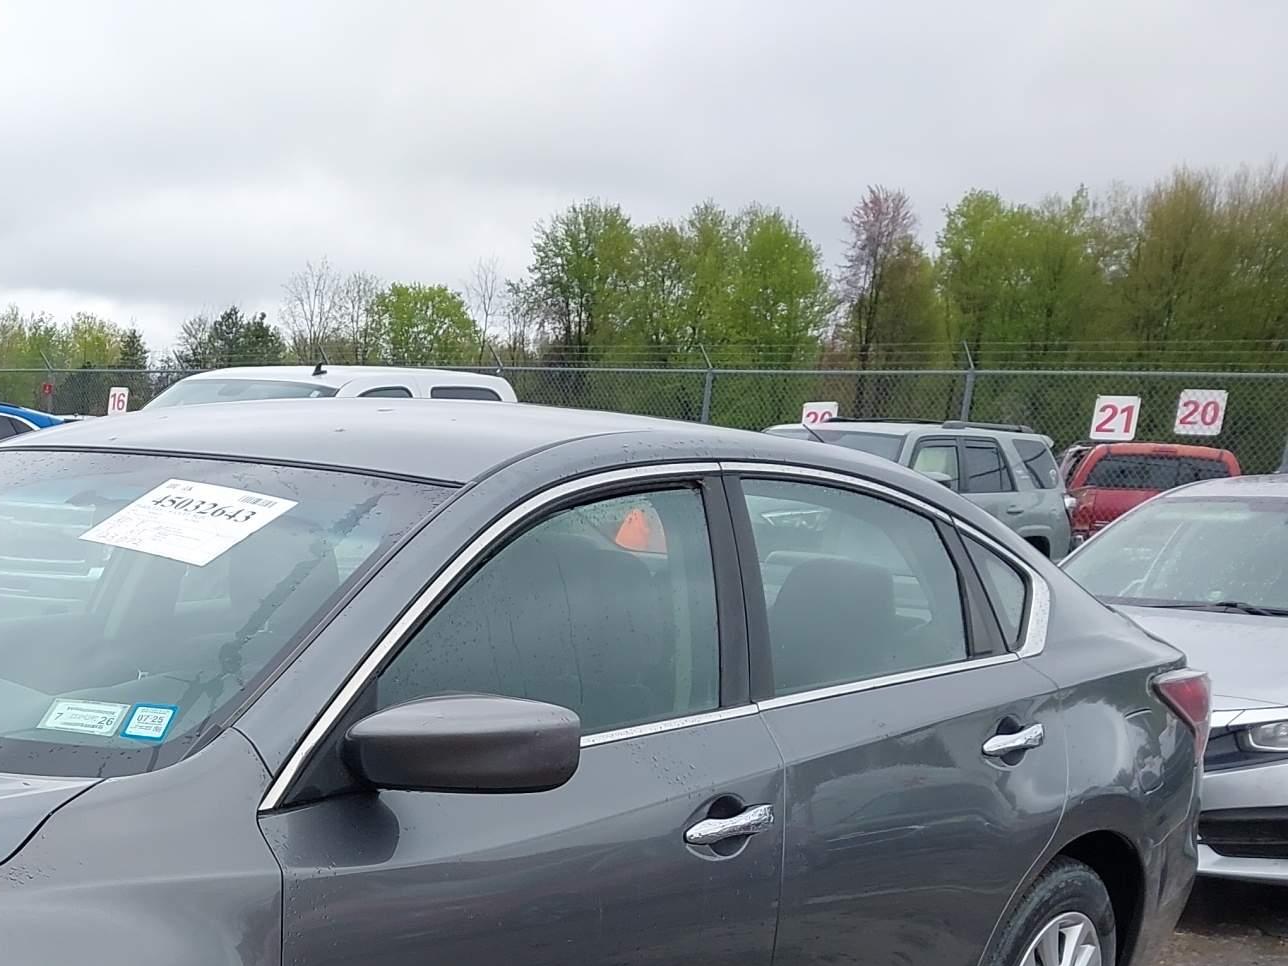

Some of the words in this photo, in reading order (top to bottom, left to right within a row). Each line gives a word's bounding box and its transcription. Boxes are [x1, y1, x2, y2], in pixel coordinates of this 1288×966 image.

[110, 392, 125, 411] 16
[1179, 400, 1220, 426] 20
[1095, 404, 1134, 433] 21
[151, 494, 257, 523] 45032643
[97, 716, 115, 726] 26
